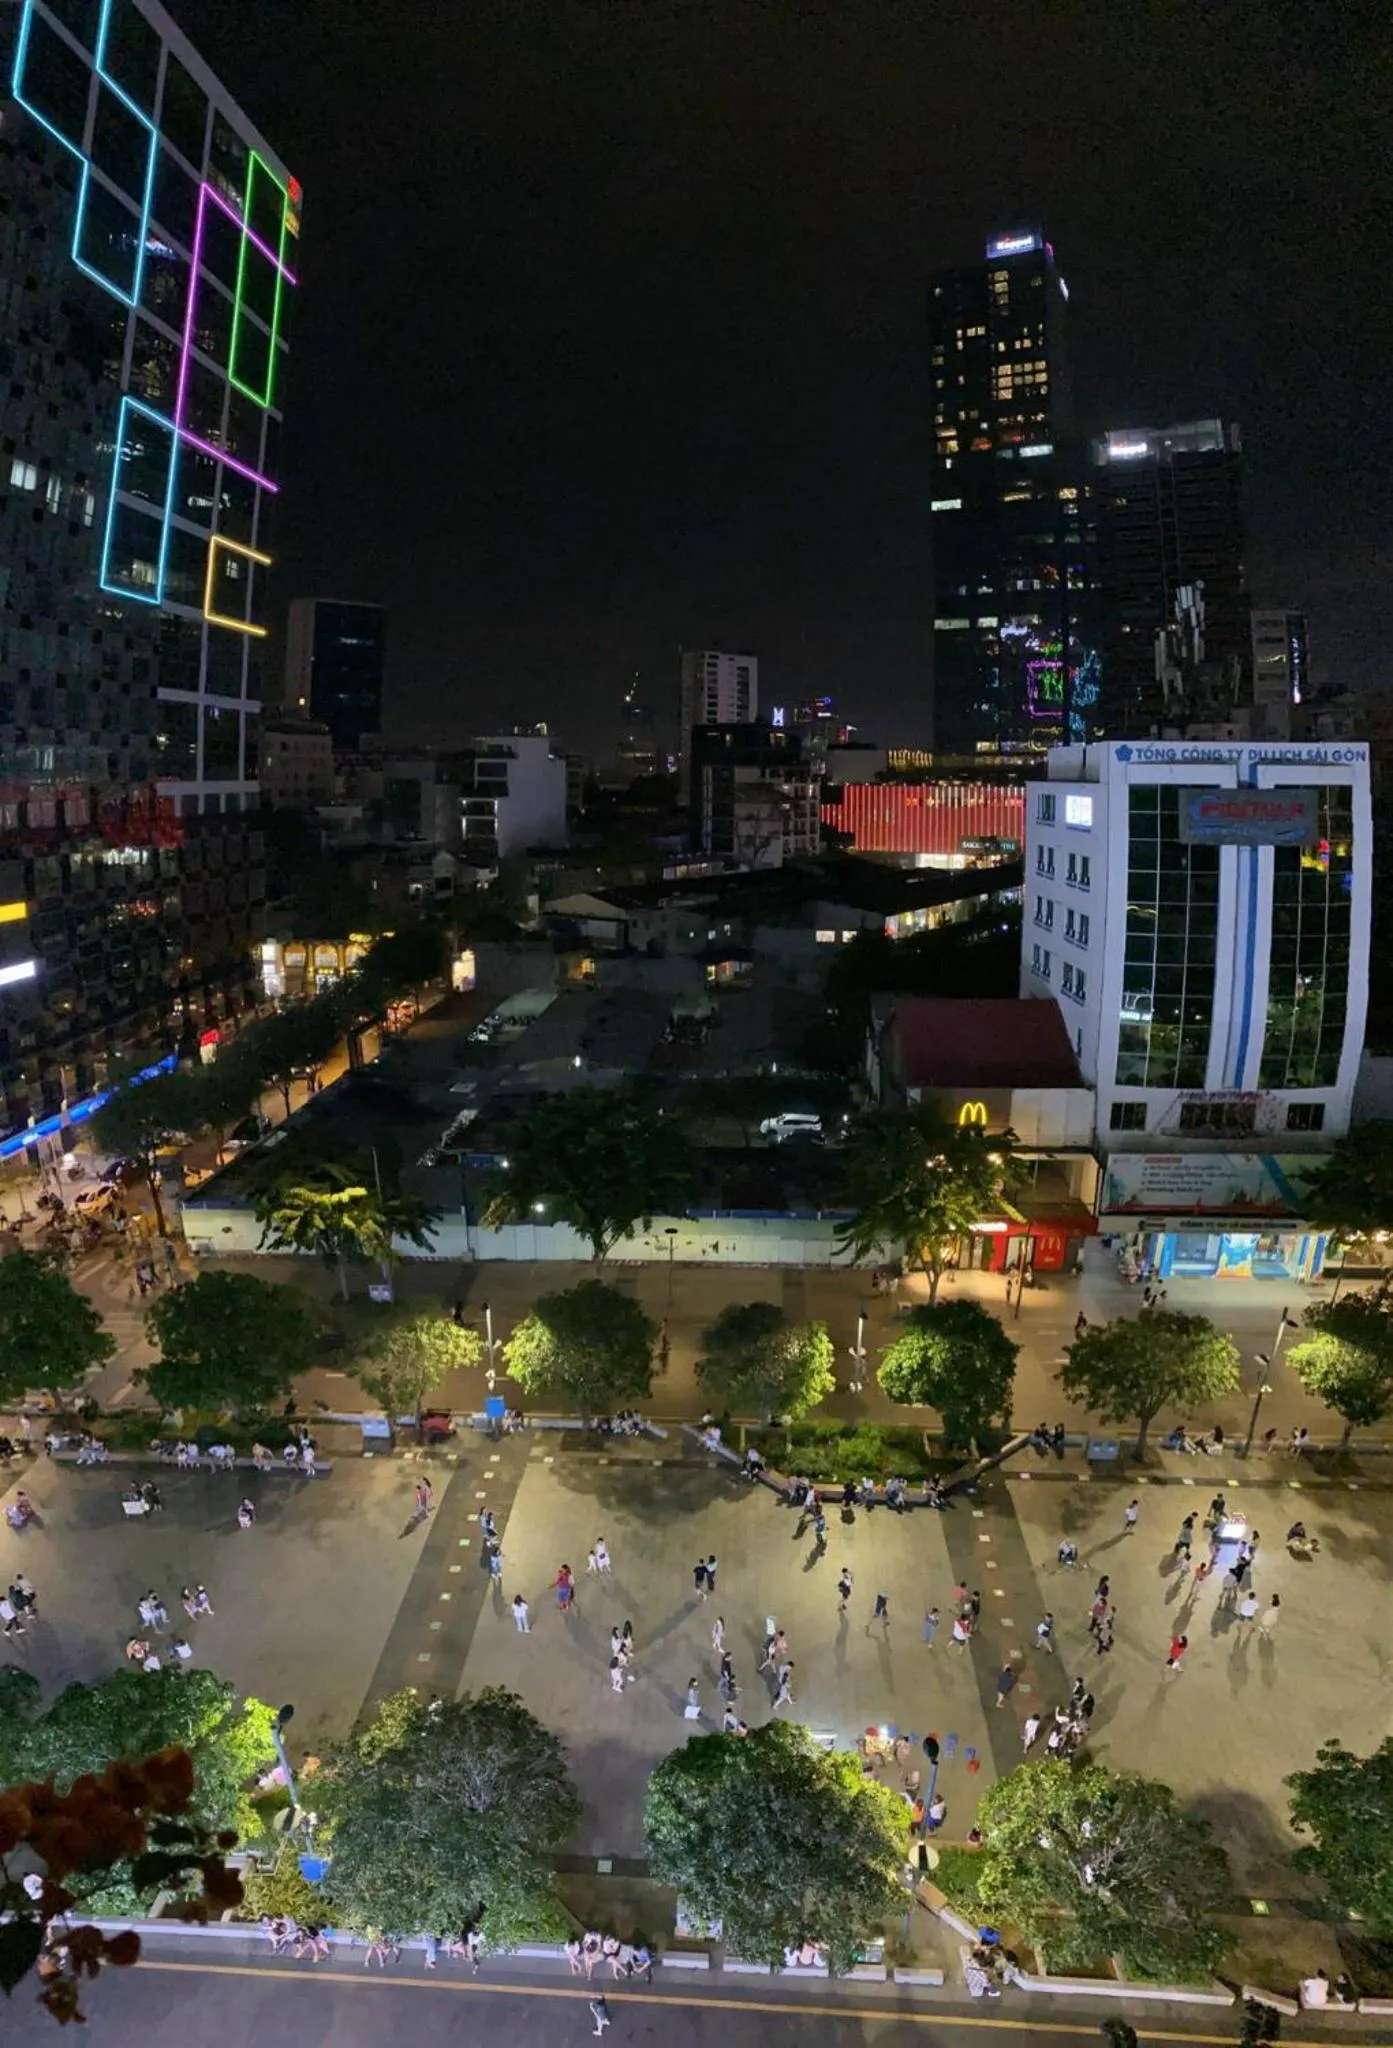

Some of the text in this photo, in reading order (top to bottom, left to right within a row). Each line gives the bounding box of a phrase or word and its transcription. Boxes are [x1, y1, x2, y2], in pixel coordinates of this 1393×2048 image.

[1181, 745, 1223, 760] CÔNG
[1227, 748, 1244, 760] TY
[1332, 746, 1367, 761] GÒN
